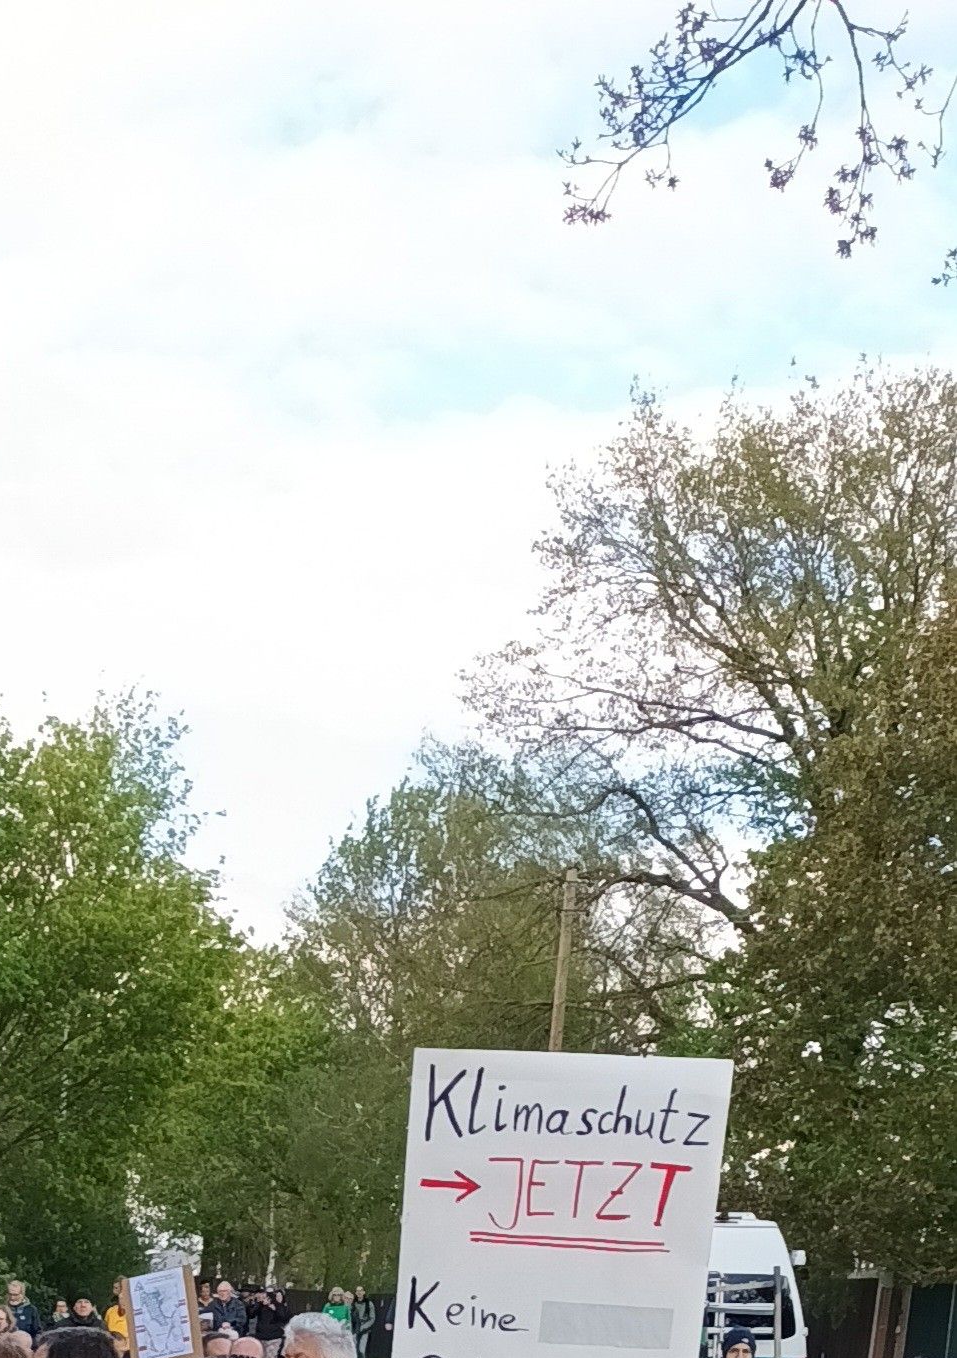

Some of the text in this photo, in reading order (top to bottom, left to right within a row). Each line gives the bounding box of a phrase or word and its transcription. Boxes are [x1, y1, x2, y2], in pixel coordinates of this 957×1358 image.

[424, 1063, 711, 1147] Klimaschutz
[488, 1156, 693, 1231] JETZT
[407, 1276, 529, 1333] Keine
